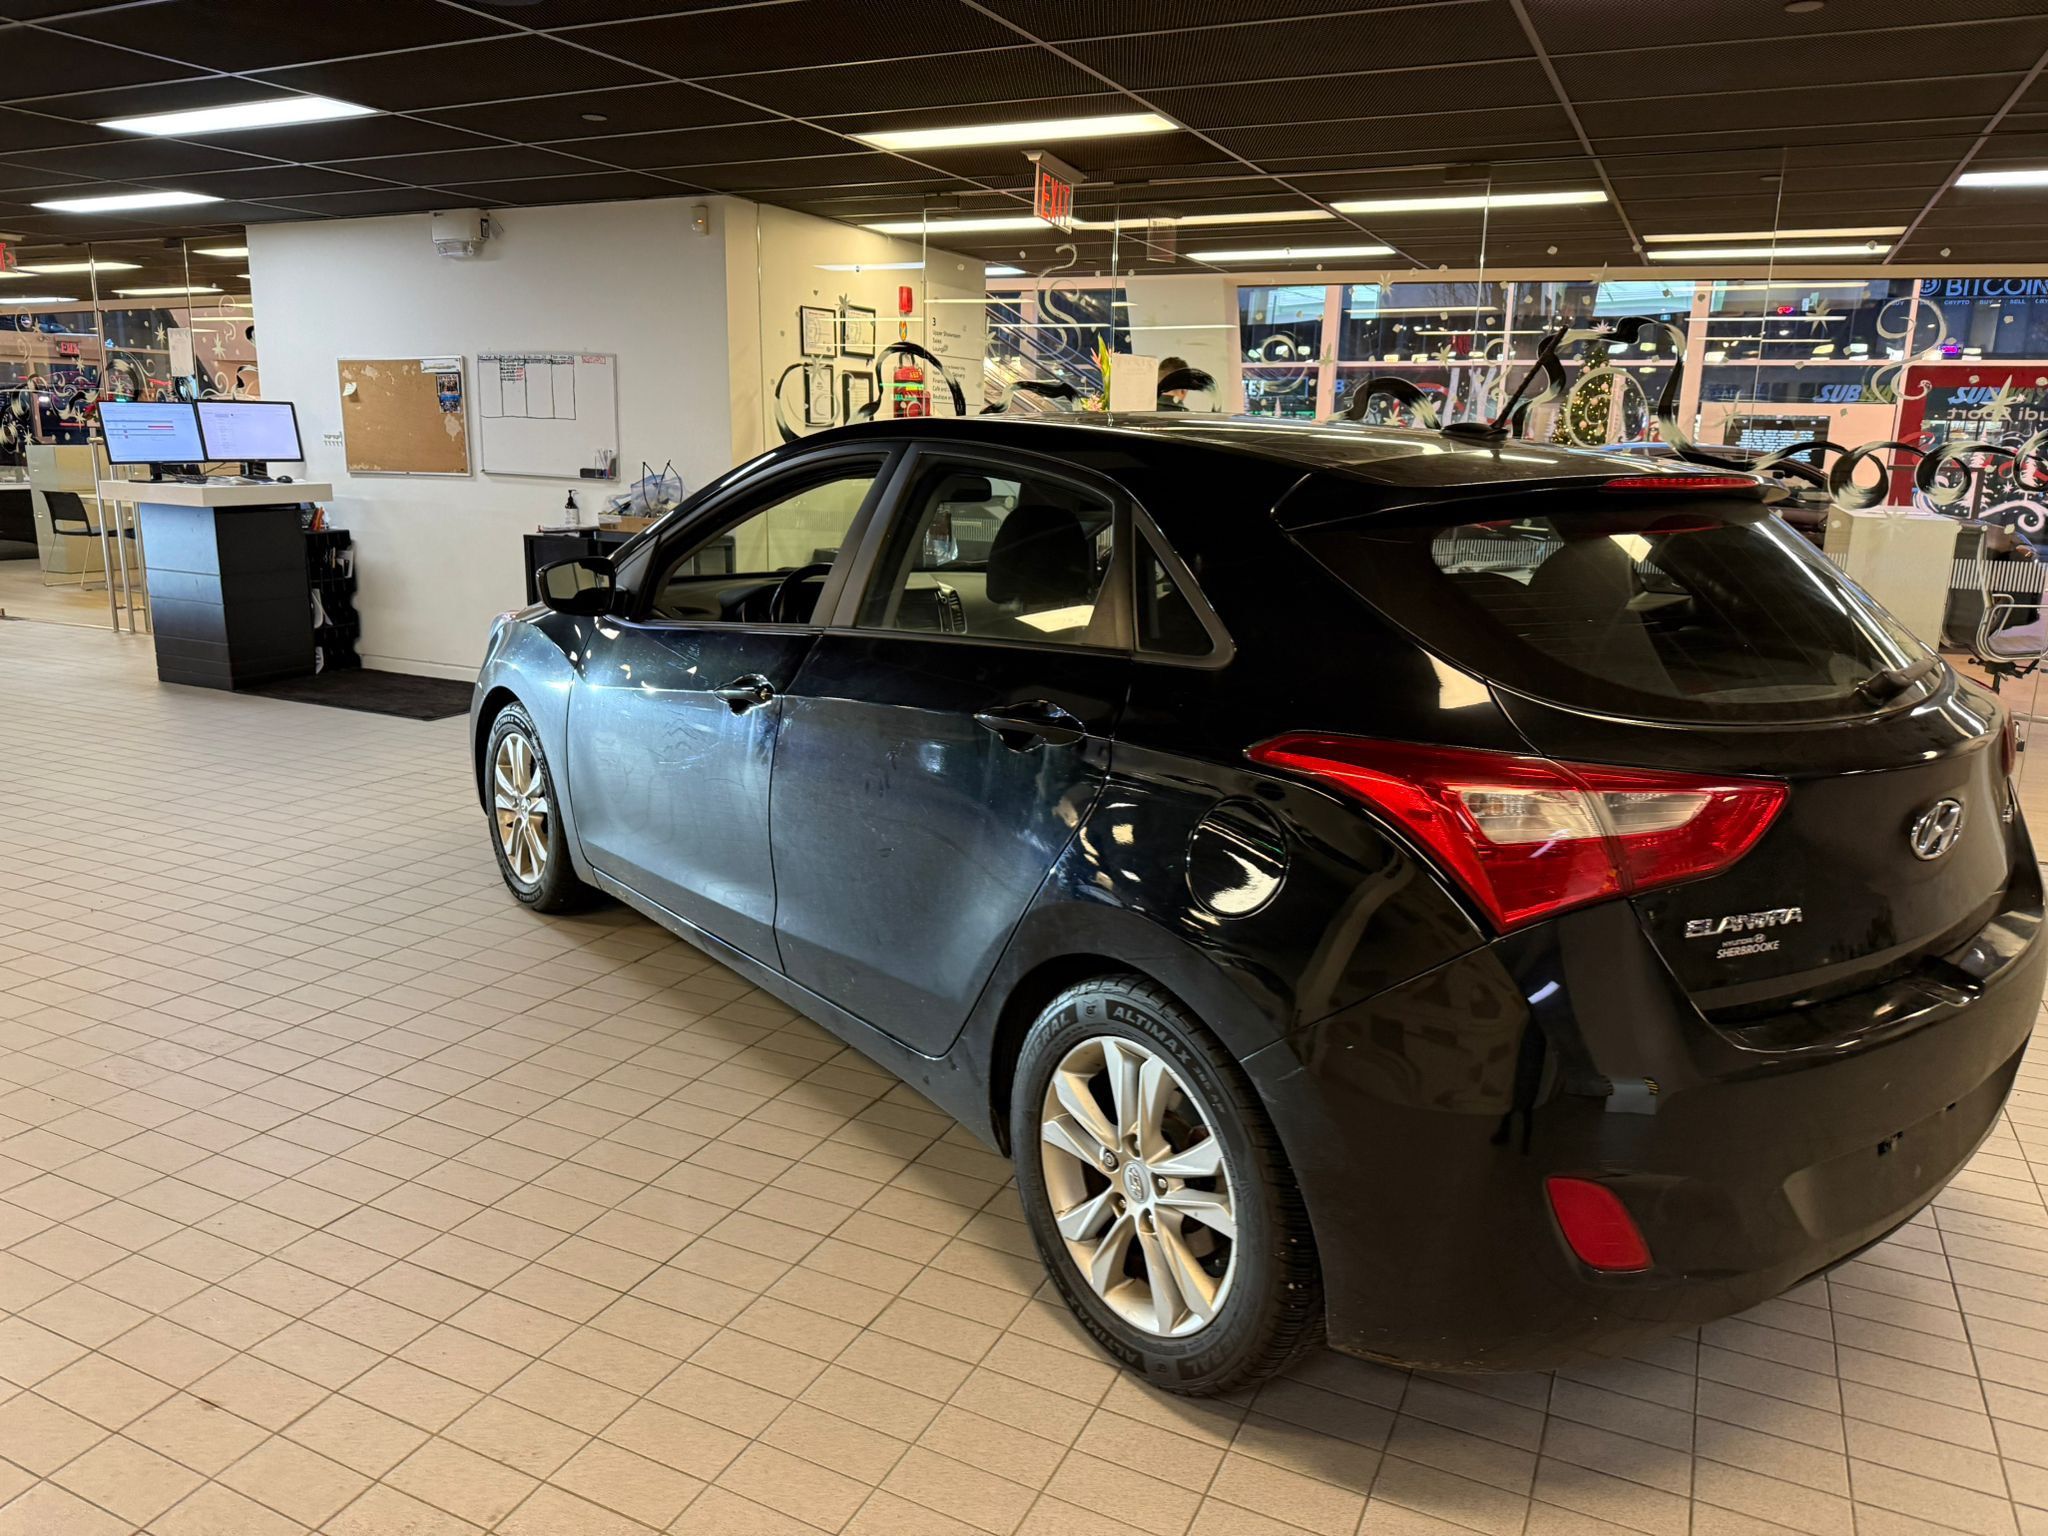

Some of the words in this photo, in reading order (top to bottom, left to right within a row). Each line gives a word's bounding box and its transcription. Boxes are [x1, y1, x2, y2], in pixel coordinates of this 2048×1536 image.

[1041, 172, 1071, 226] EXIT
[932, 317, 936, 326] 3
[1812, 384, 1896, 402] SUBWA
[1684, 907, 1803, 938] ELANTRA
[1716, 941, 1780, 959] SHERBROOKE
[1113, 1006, 1191, 1063] ALTIMAX
[1067, 1297, 1137, 1362] ALTIMAX
